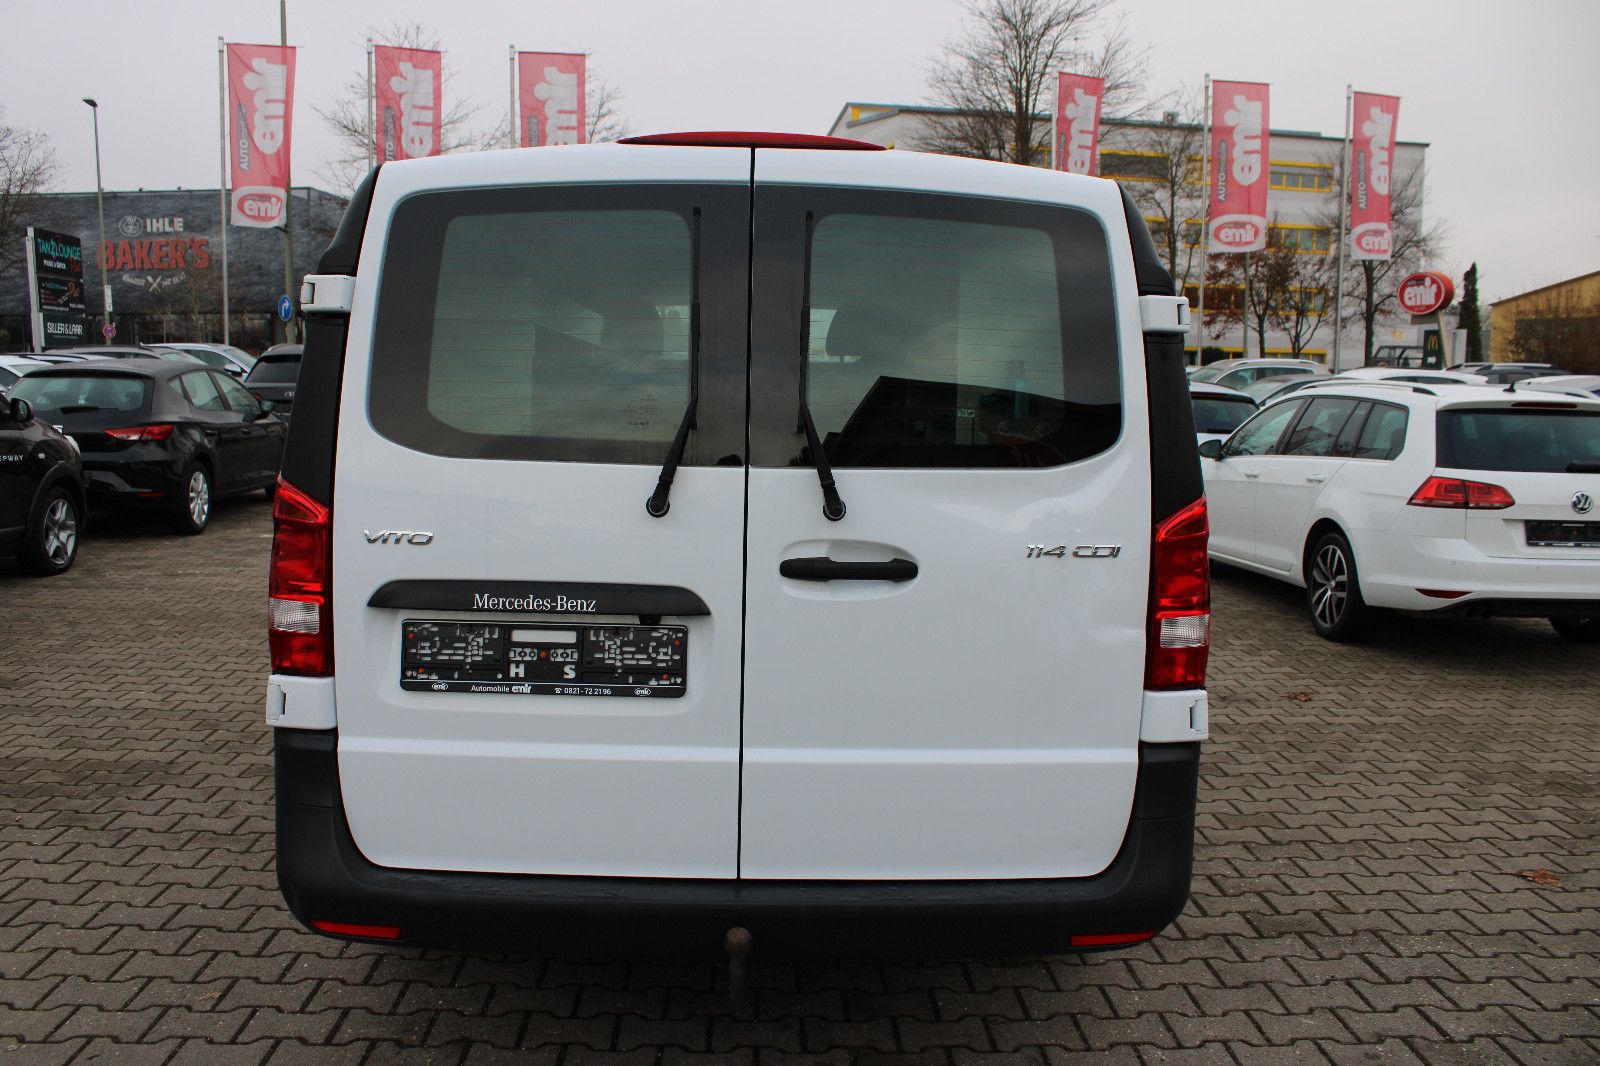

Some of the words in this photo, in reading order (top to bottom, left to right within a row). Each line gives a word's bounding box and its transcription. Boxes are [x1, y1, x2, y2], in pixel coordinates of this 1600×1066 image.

[243, 58, 287, 154] emir
[390, 62, 433, 157] emir
[1224, 95, 1262, 187] emir
[1361, 106, 1393, 196] emir
[146, 216, 184, 233] IHLE
[98, 236, 210, 270] BAKER'S
[1404, 276, 1437, 306] emir
[363, 529, 434, 545] VITO
[1026, 544, 1066, 558] 114
[1072, 544, 1122, 558] CDI
[472, 593, 597, 612] Mercedes-Benz
[509, 663, 525, 678] H
[563, 664, 576, 679] S
[471, 684, 509, 692] Automobile
[511, 683, 532, 694] emir
